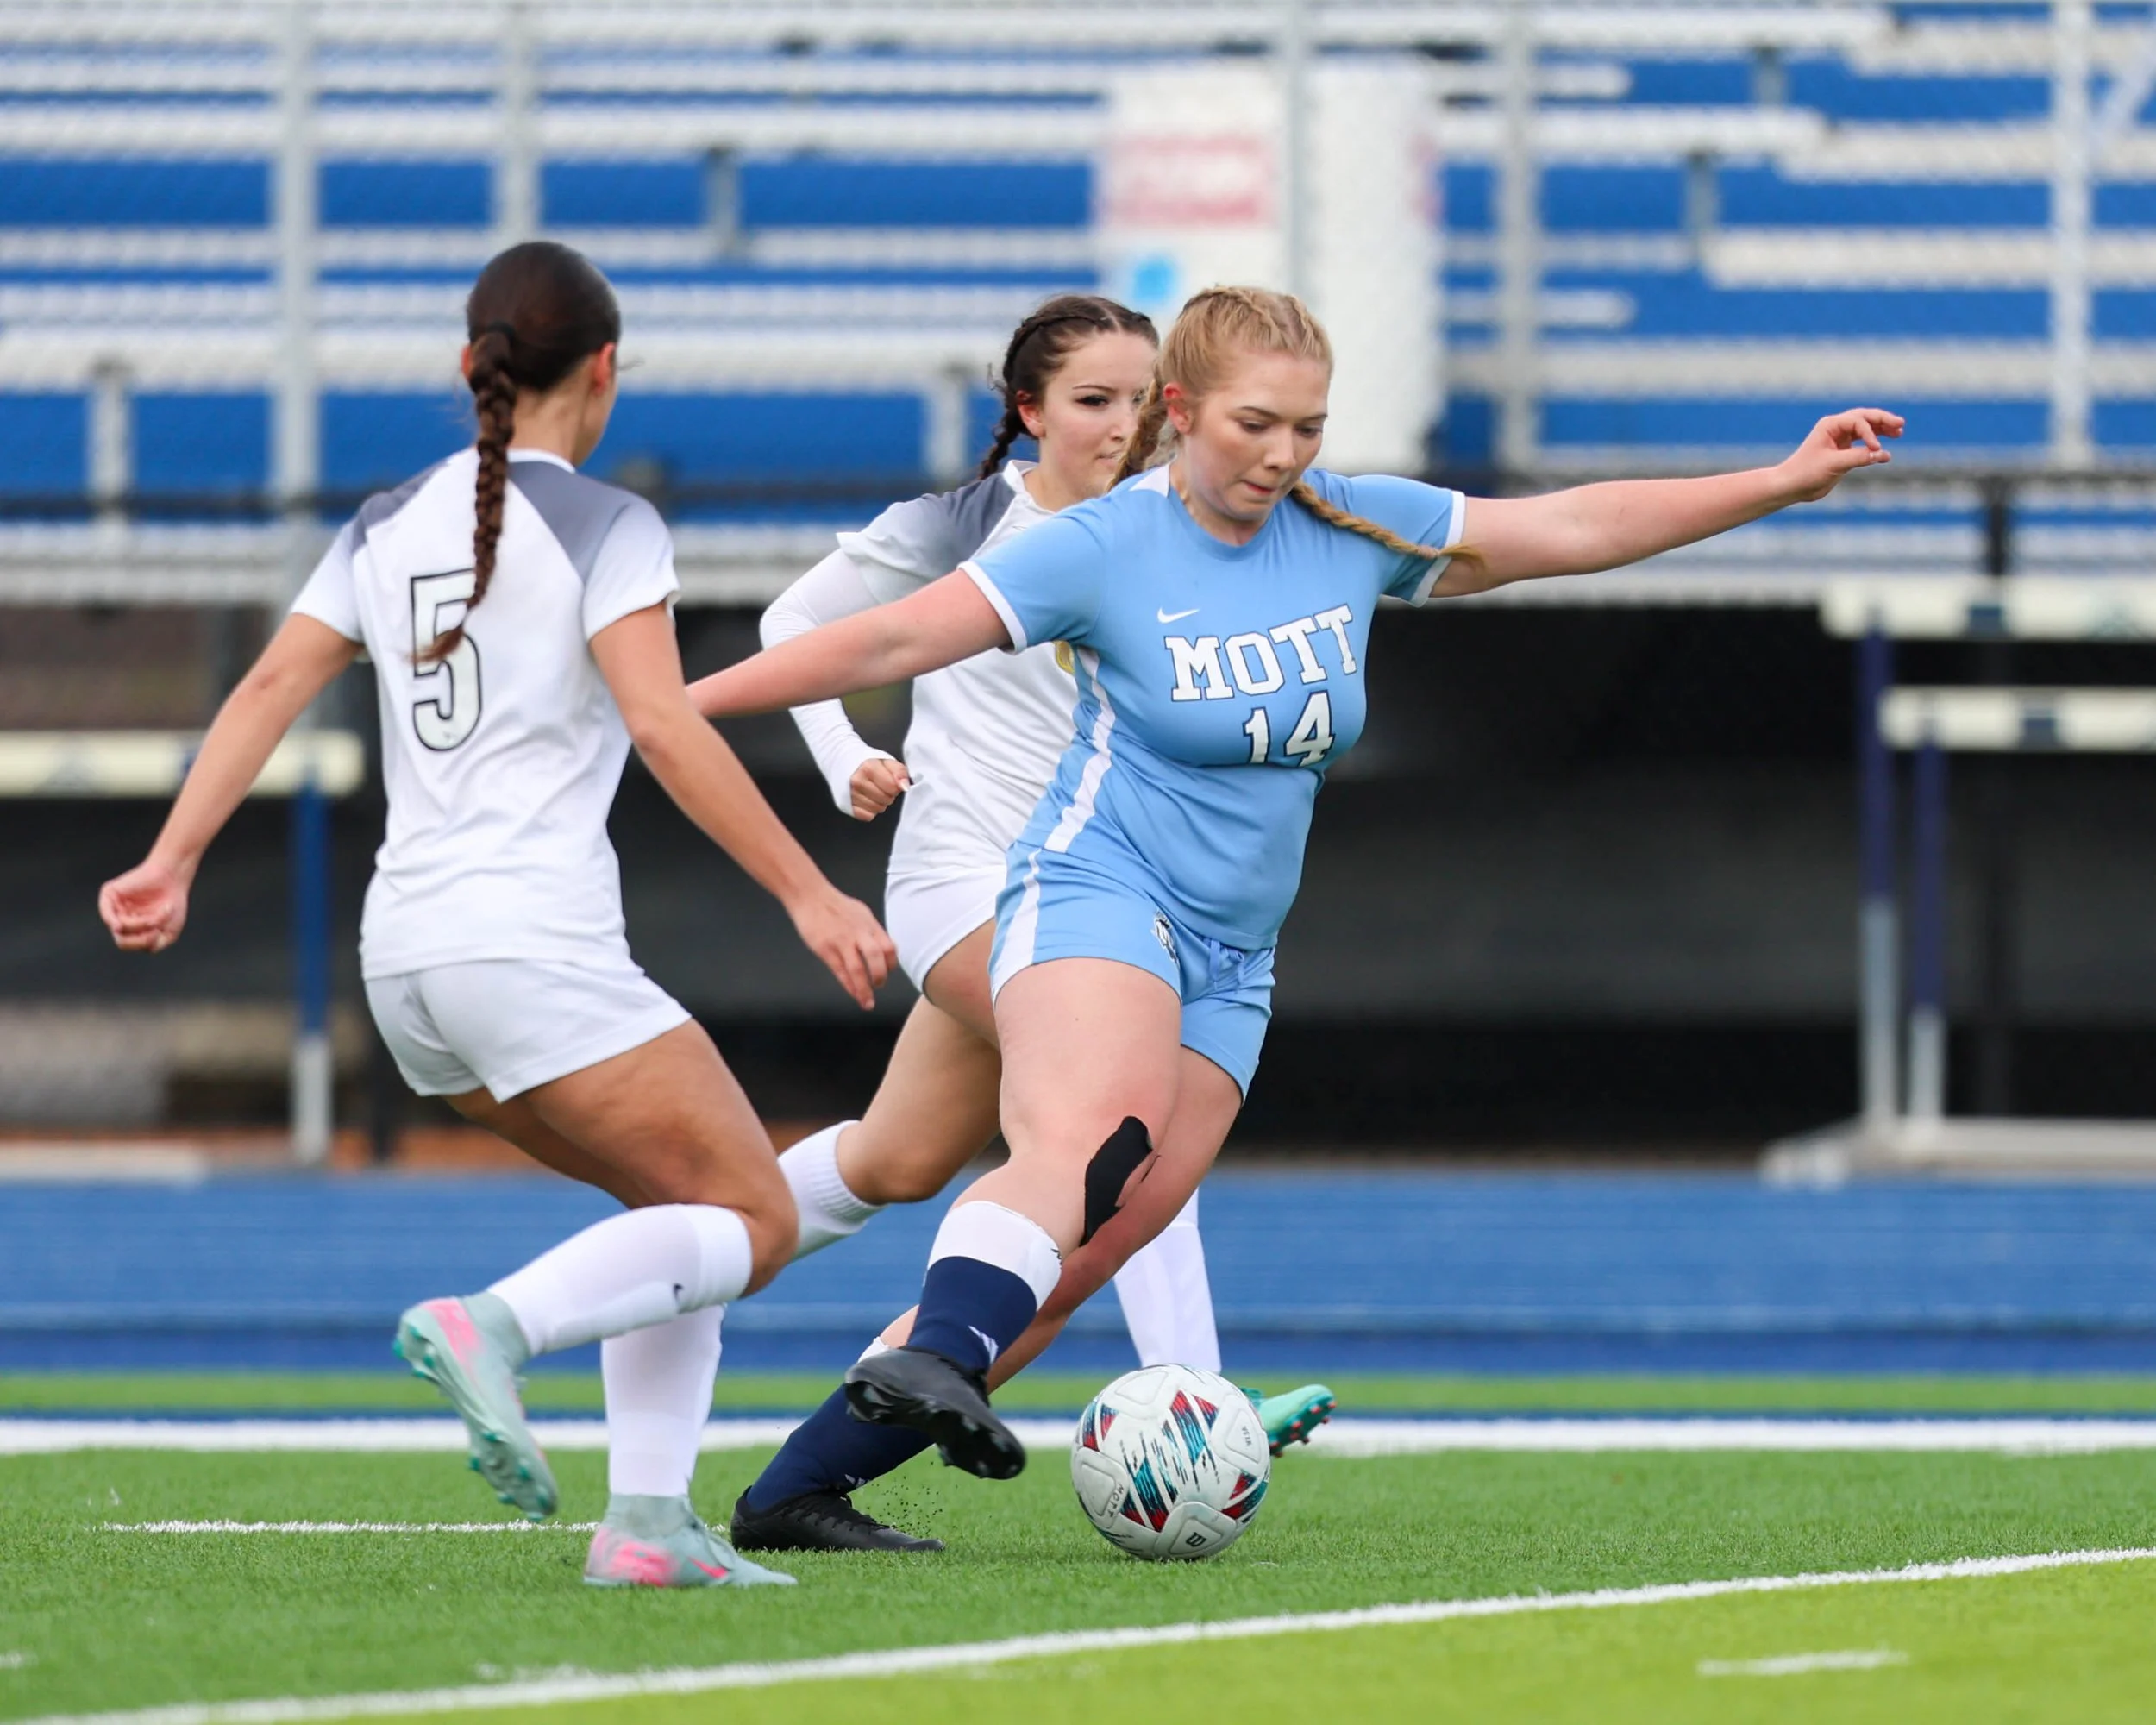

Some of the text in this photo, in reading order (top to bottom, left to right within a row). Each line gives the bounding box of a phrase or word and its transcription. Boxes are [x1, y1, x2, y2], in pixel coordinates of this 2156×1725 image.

[410, 568, 482, 752] 5
[1164, 603, 1358, 702] MOTT
[1242, 689, 1336, 767] 14
